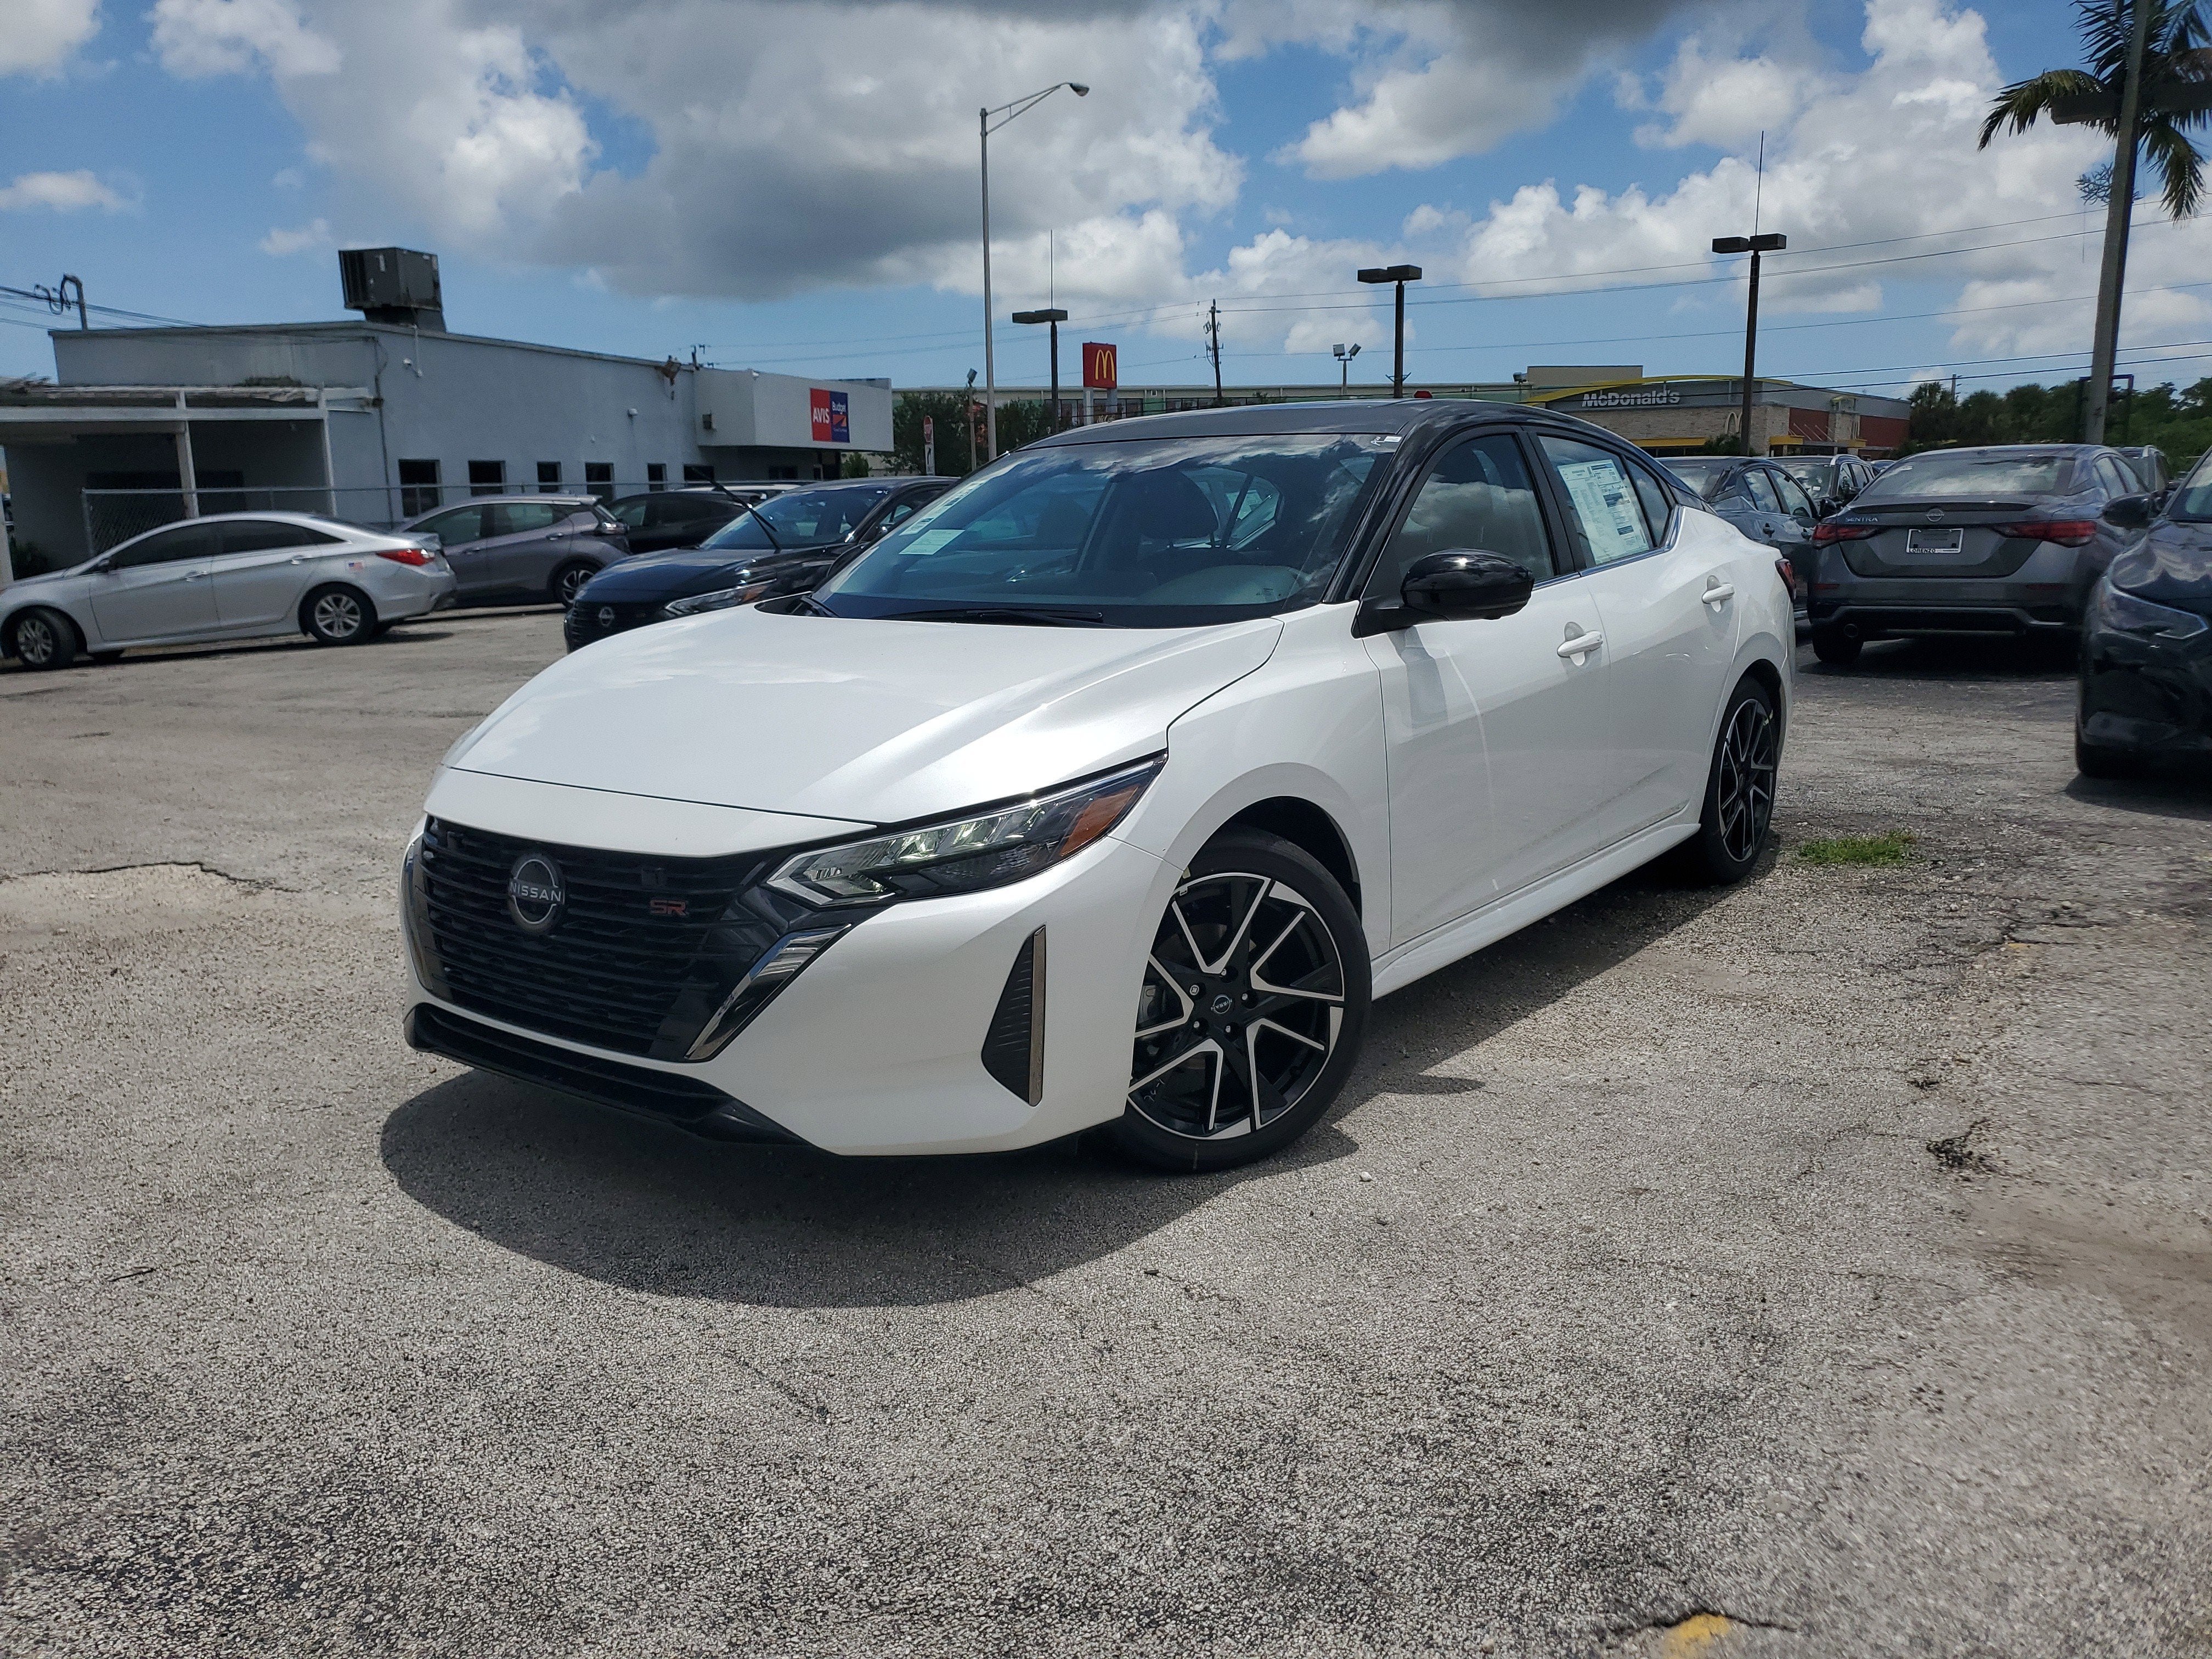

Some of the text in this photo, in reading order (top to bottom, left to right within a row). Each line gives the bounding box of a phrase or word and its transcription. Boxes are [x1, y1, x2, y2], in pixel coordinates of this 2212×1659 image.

[1582, 390, 1680, 407] McDonald's
[813, 407, 830, 424] AVIS
[832, 401, 847, 415] Budget
[510, 881, 561, 901] NISSAN
[650, 900, 686, 916] SR
